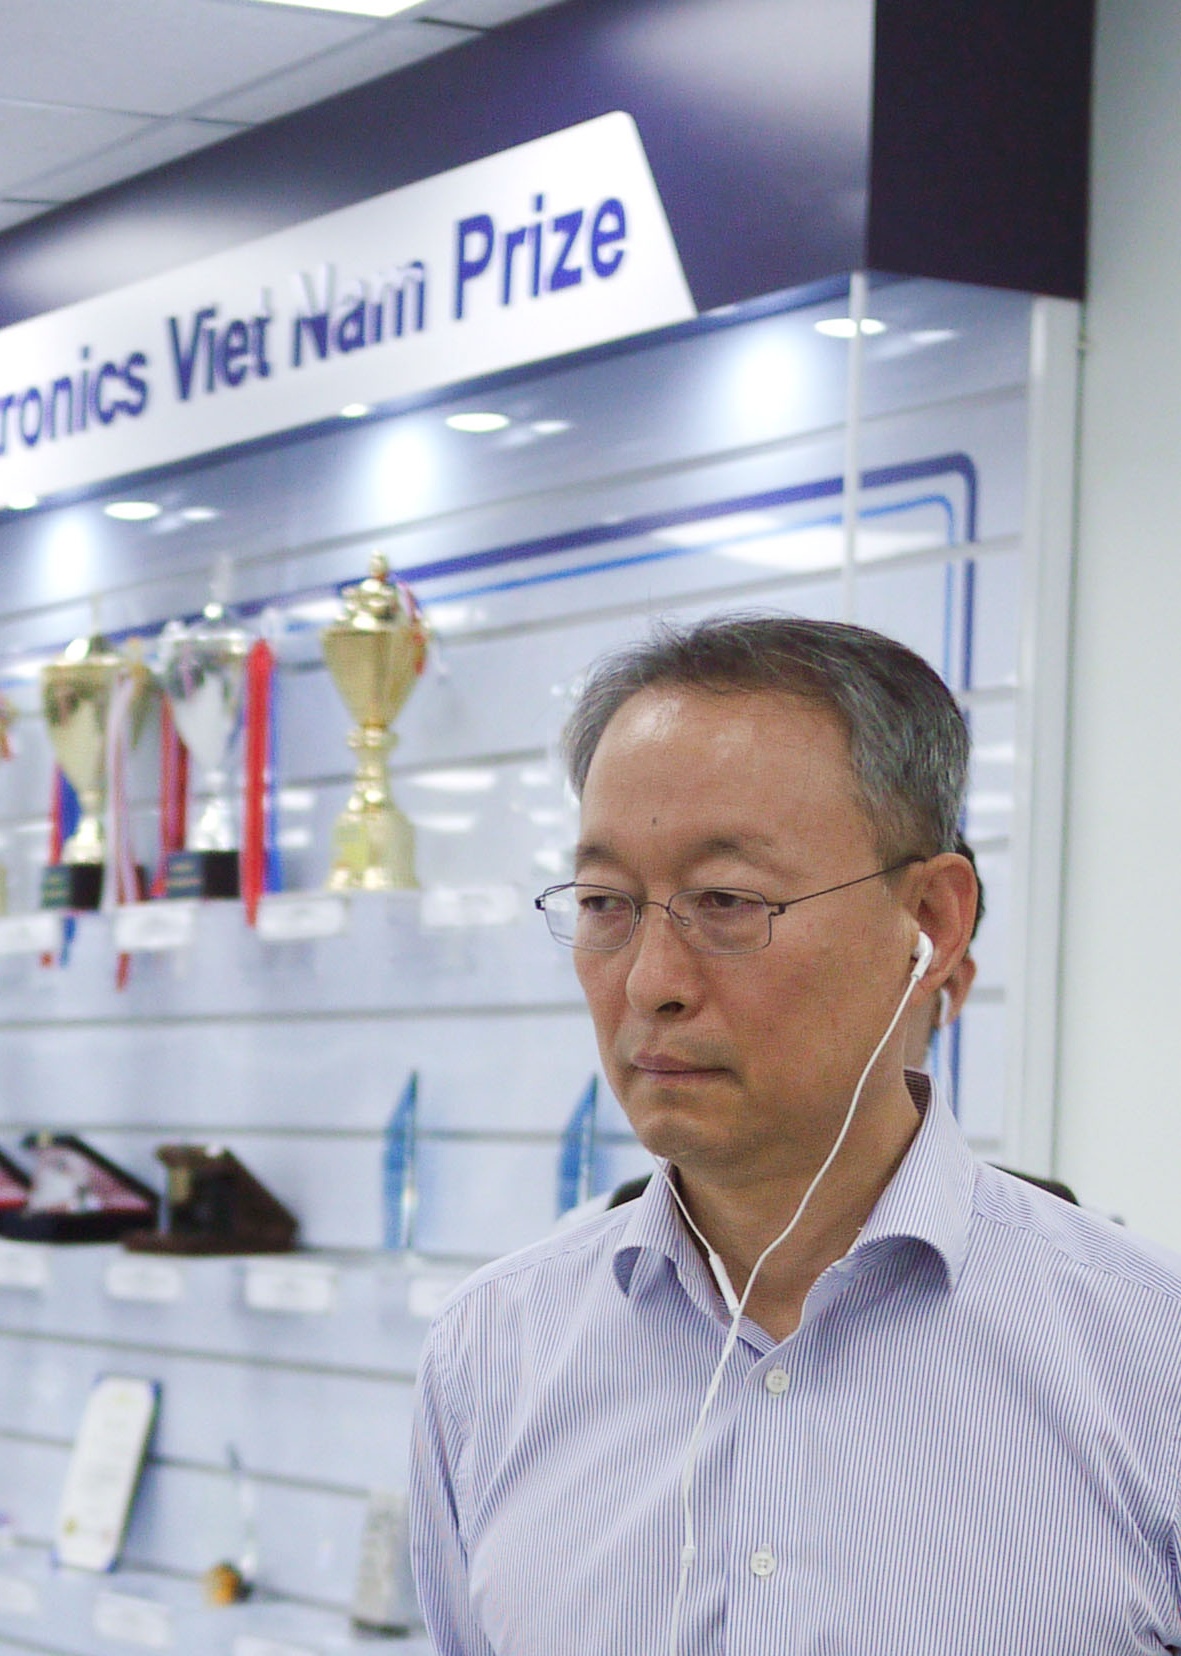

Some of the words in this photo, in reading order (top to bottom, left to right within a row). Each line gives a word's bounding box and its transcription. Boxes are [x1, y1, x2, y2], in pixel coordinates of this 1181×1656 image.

[168, 288, 274, 401] Viet
[292, 261, 426, 368] Nam
[454, 192, 627, 322] Prize
